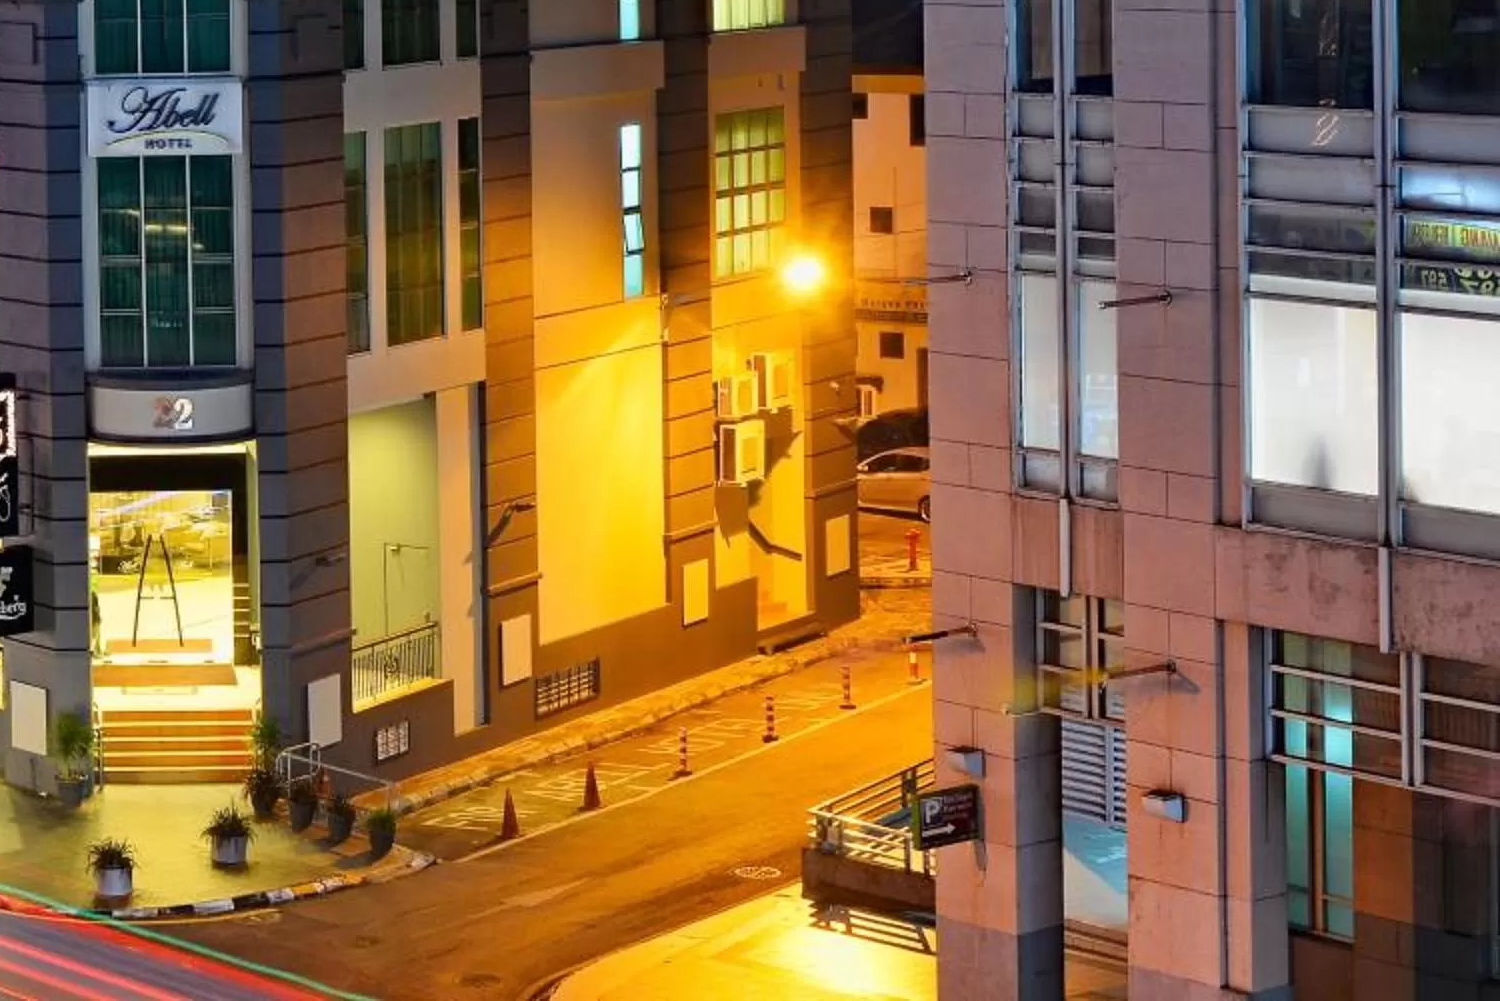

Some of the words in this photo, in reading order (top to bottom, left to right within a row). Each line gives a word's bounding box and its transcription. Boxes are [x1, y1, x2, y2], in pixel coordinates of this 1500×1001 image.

[107, 86, 221, 133] Abell
[145, 137, 193, 150] HOTEL
[925, 800, 940, 824] P
